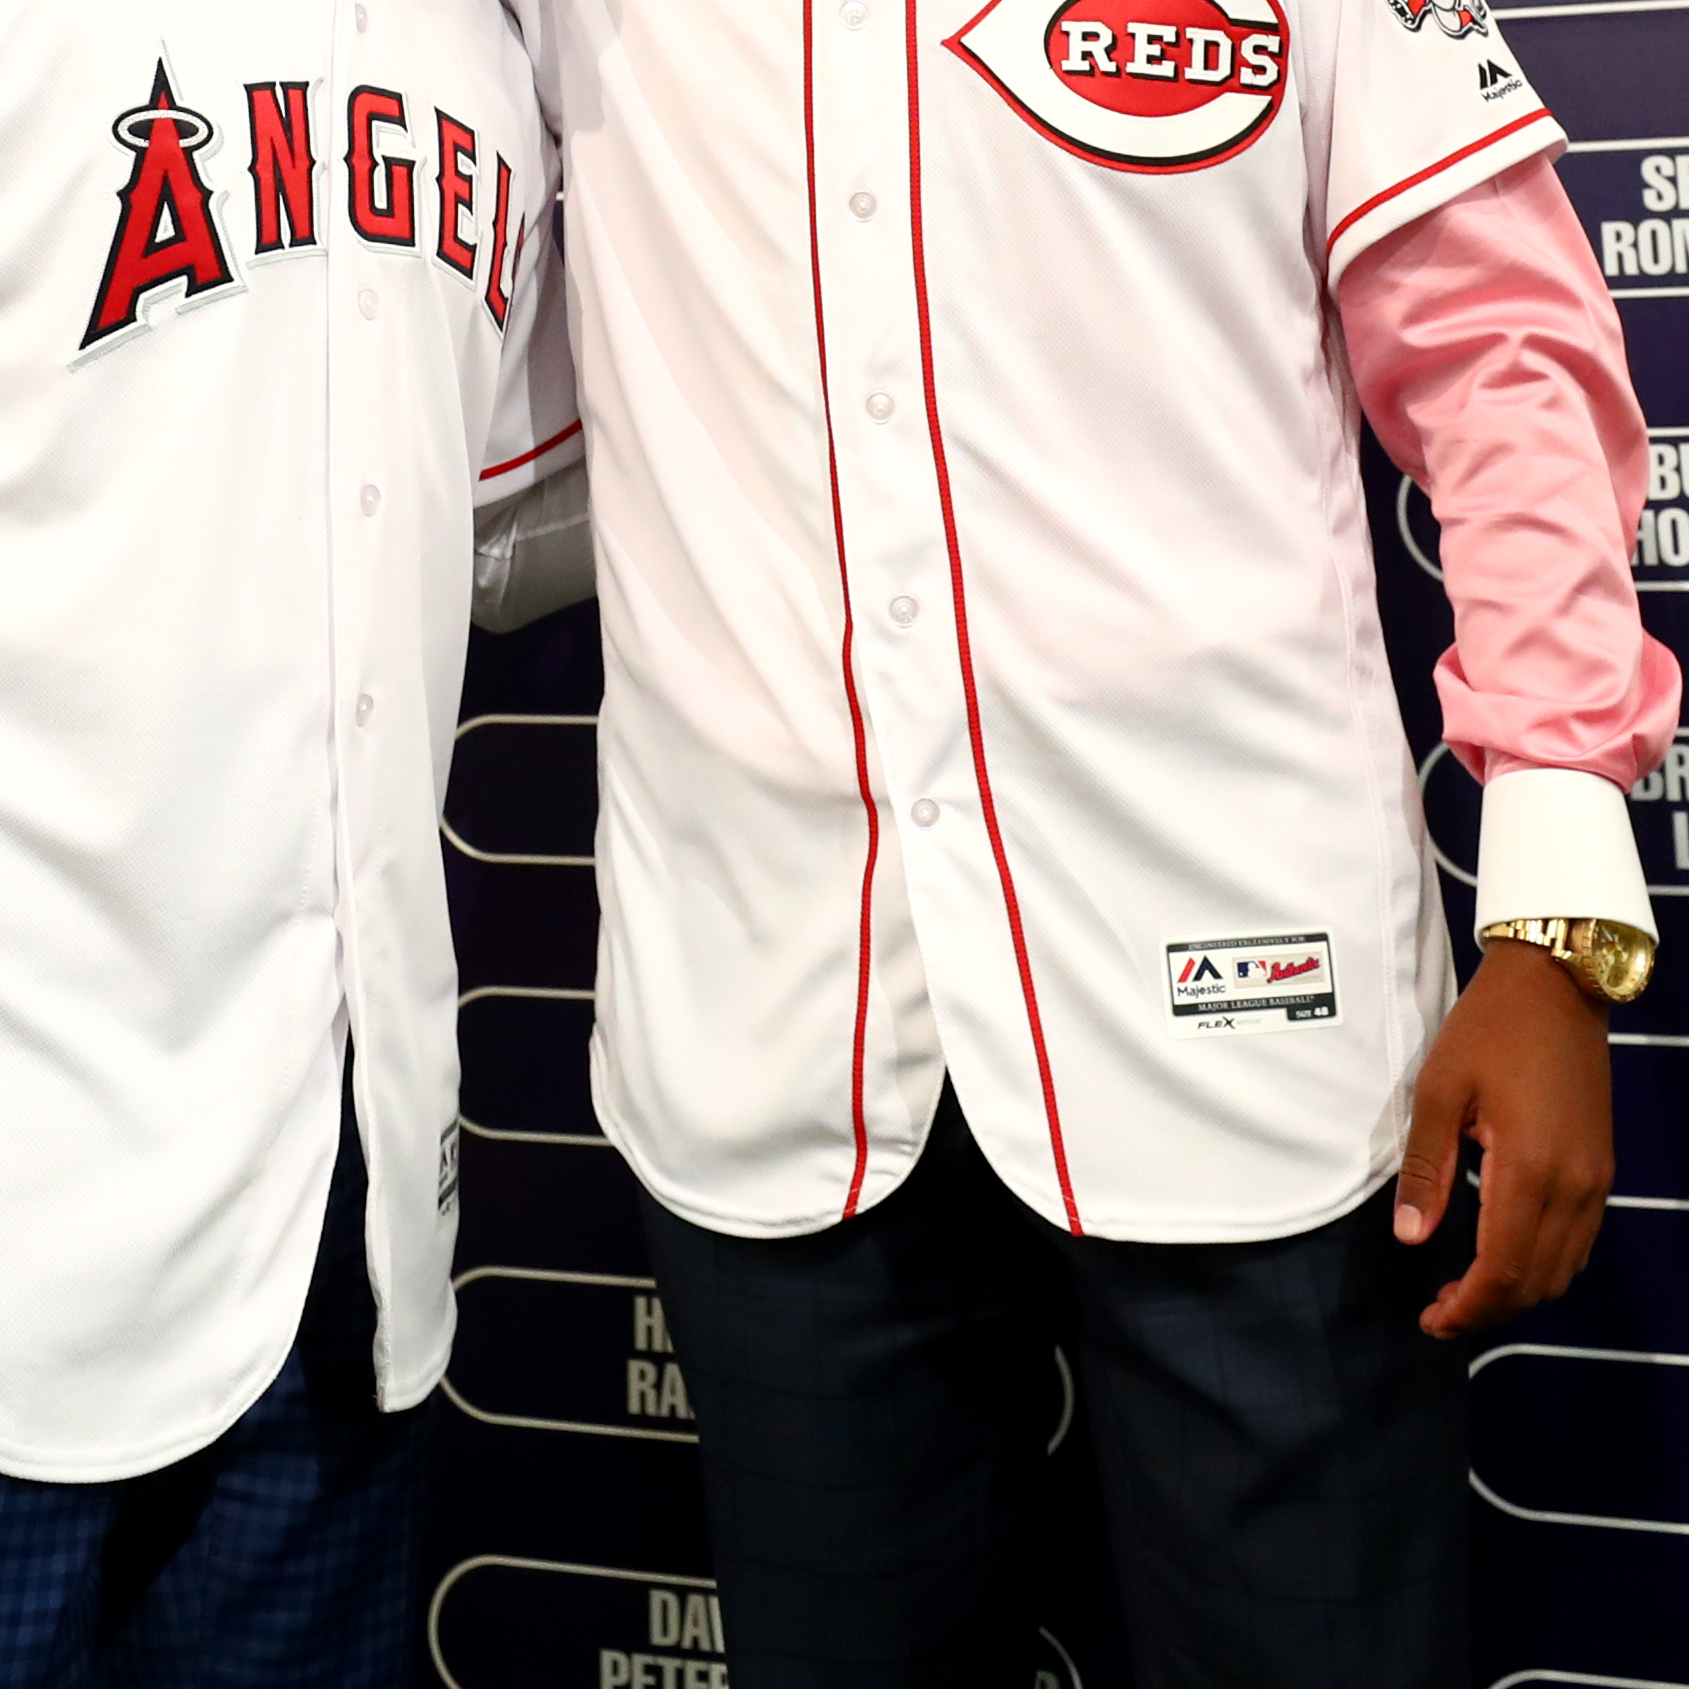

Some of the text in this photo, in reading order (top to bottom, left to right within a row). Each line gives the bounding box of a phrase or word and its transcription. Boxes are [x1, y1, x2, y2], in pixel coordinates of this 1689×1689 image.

[1060, 19, 1287, 91] REDS
[74, 55, 526, 355] ANGEL
[1177, 984, 1226, 998] Majestic
[1198, 1002, 1230, 1011] MAJOR
[1231, 998, 1268, 1009] LEAGUE
